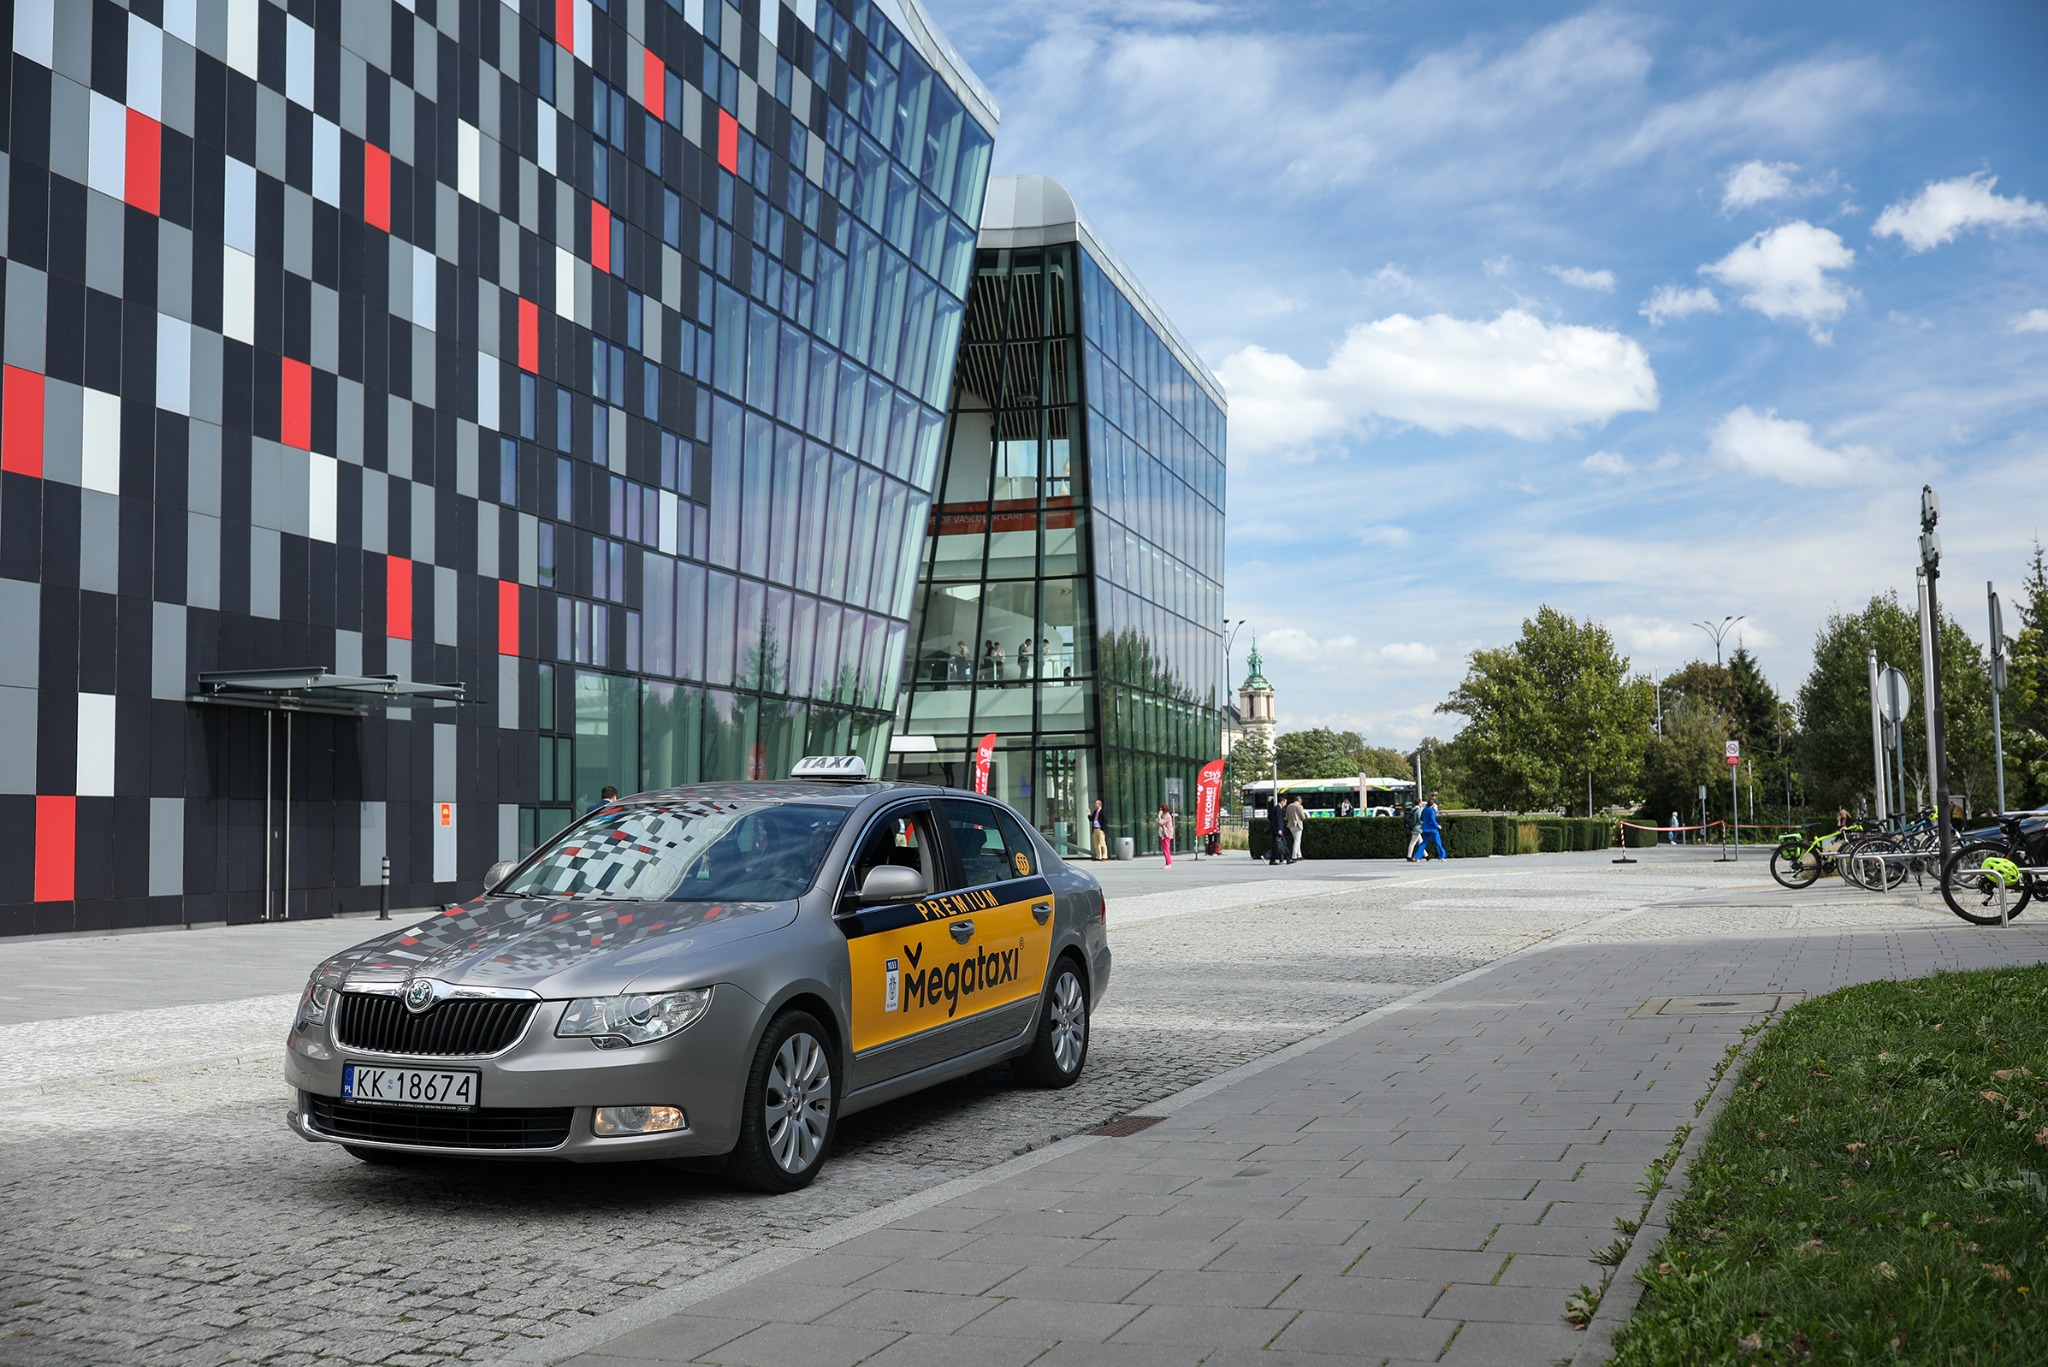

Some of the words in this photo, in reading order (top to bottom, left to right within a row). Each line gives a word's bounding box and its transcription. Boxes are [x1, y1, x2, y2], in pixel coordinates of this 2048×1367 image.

[953, 513, 1000, 523] VASCULR
[801, 756, 855, 769] TAXI
[915, 889, 1000, 921] PREMIUM
[903, 942, 1019, 1018] Megataxi
[344, 1085, 352, 1093] PL
[357, 1069, 386, 1098] KK
[397, 1071, 470, 1103] 18674
